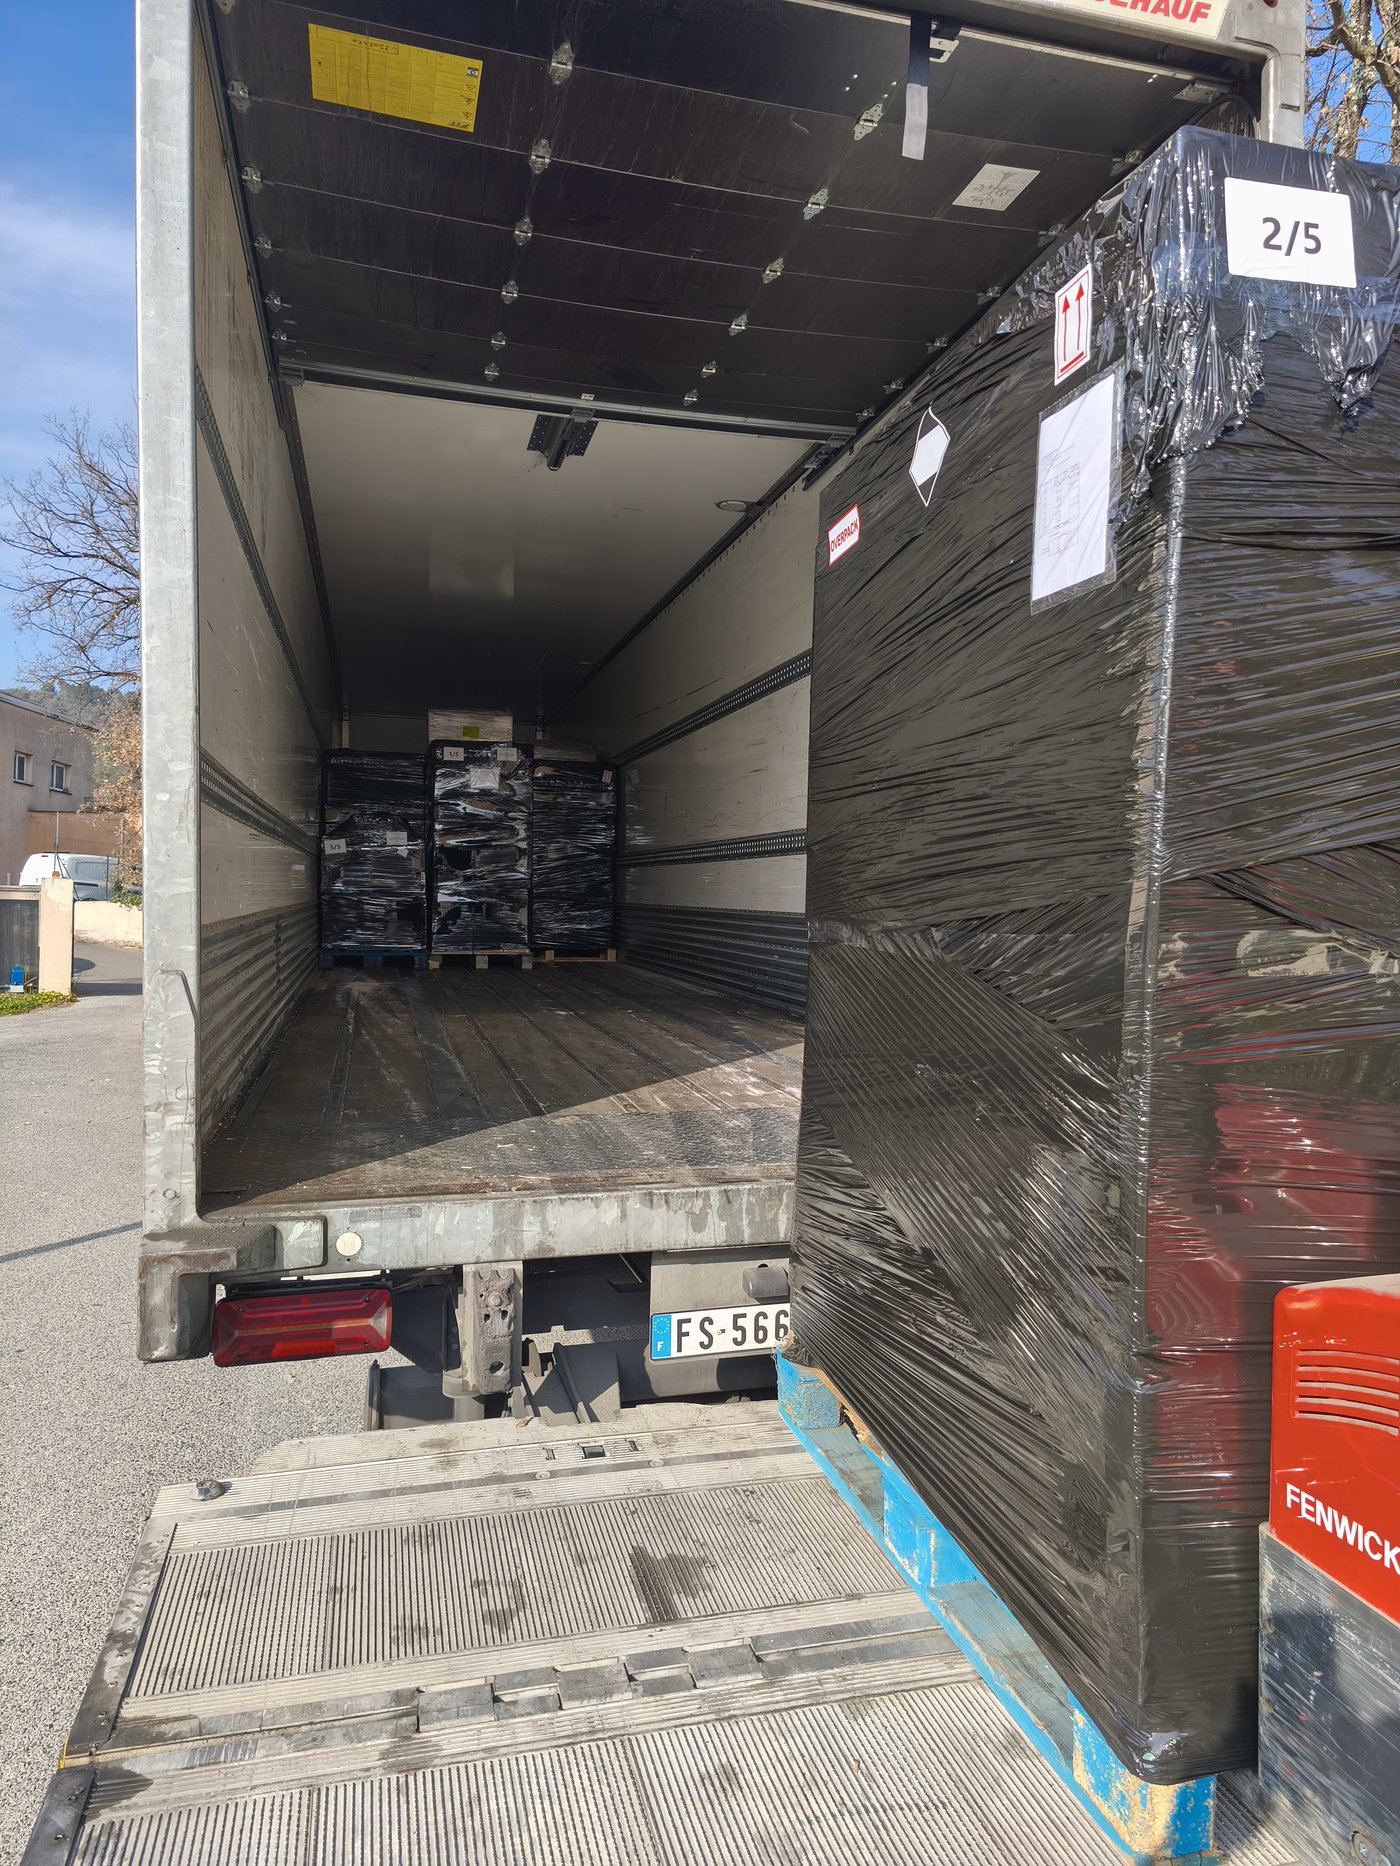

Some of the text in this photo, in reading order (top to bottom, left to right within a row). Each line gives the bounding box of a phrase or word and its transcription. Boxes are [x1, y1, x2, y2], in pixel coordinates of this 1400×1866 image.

[1092, 0, 1212, 23] HAUF
[1262, 216, 1322, 257] 2/5
[831, 517, 859, 552] OVERPACK
[656, 1341, 664, 1352] F
[677, 1309, 790, 1353] FS-566
[1286, 1482, 1400, 1576] FENWICK
